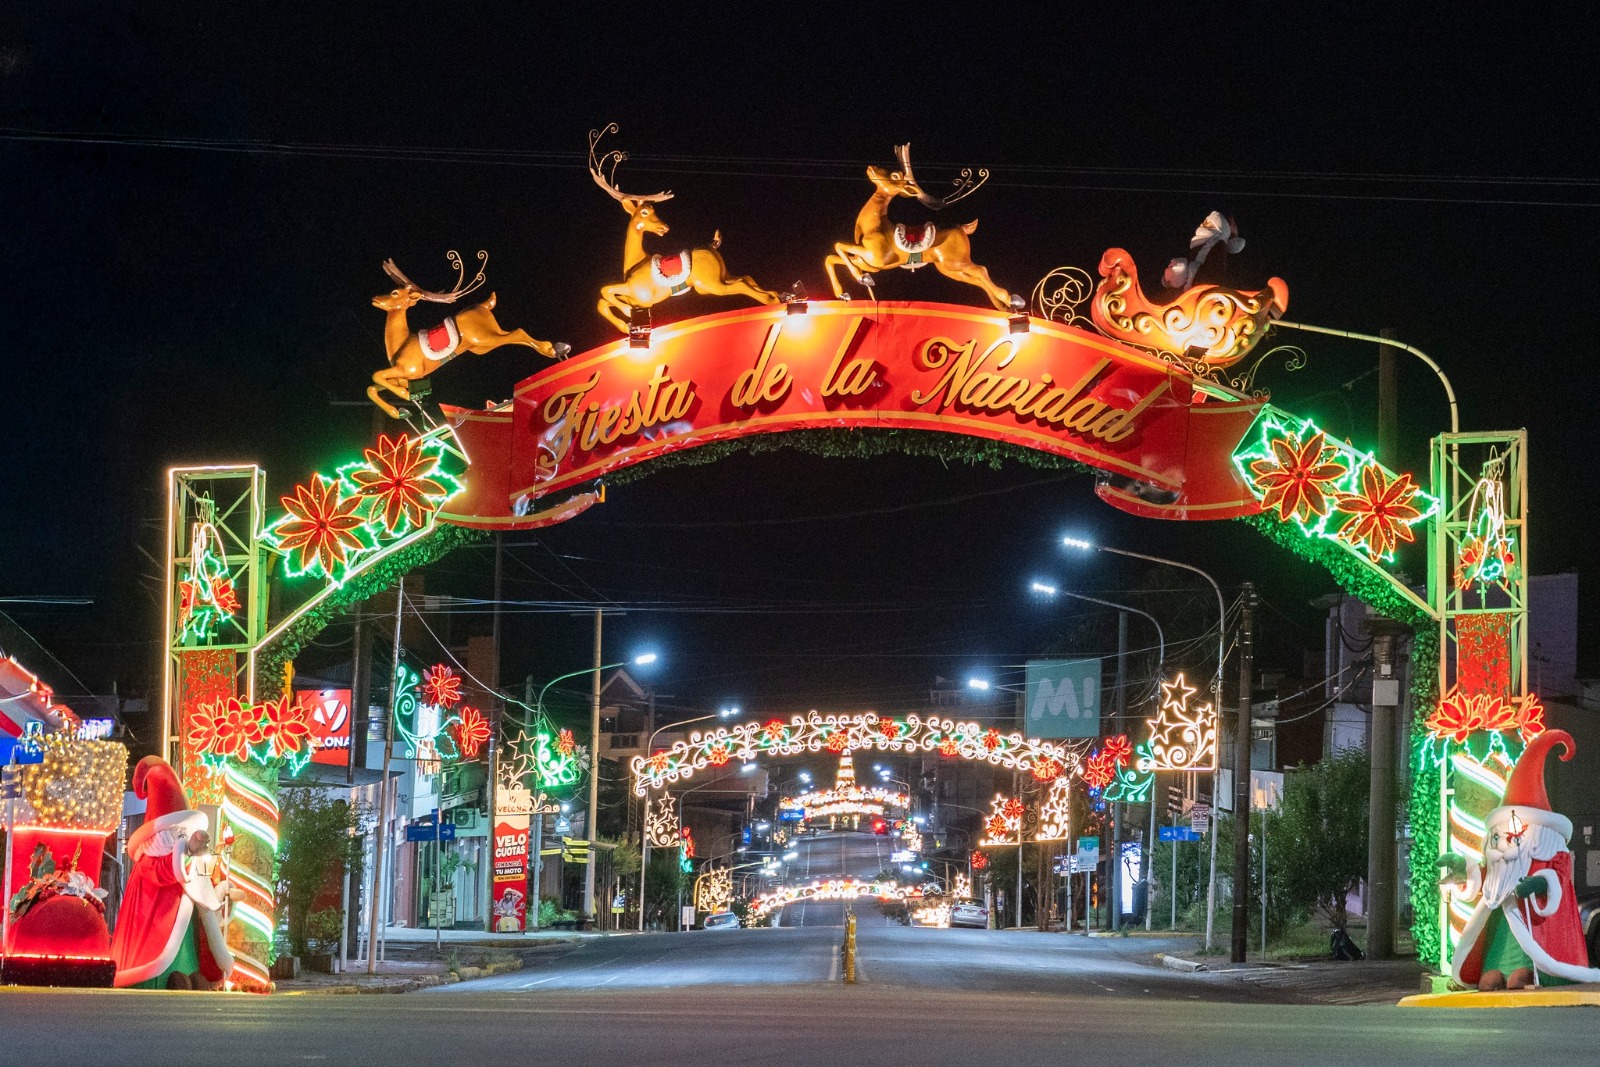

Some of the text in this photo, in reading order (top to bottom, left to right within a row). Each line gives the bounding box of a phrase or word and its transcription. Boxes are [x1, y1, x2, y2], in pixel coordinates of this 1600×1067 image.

[540, 317, 1171, 468] Fiesta de la Navidad
[496, 833, 526, 847] VELO
[496, 846, 526, 858] CUOTAS
